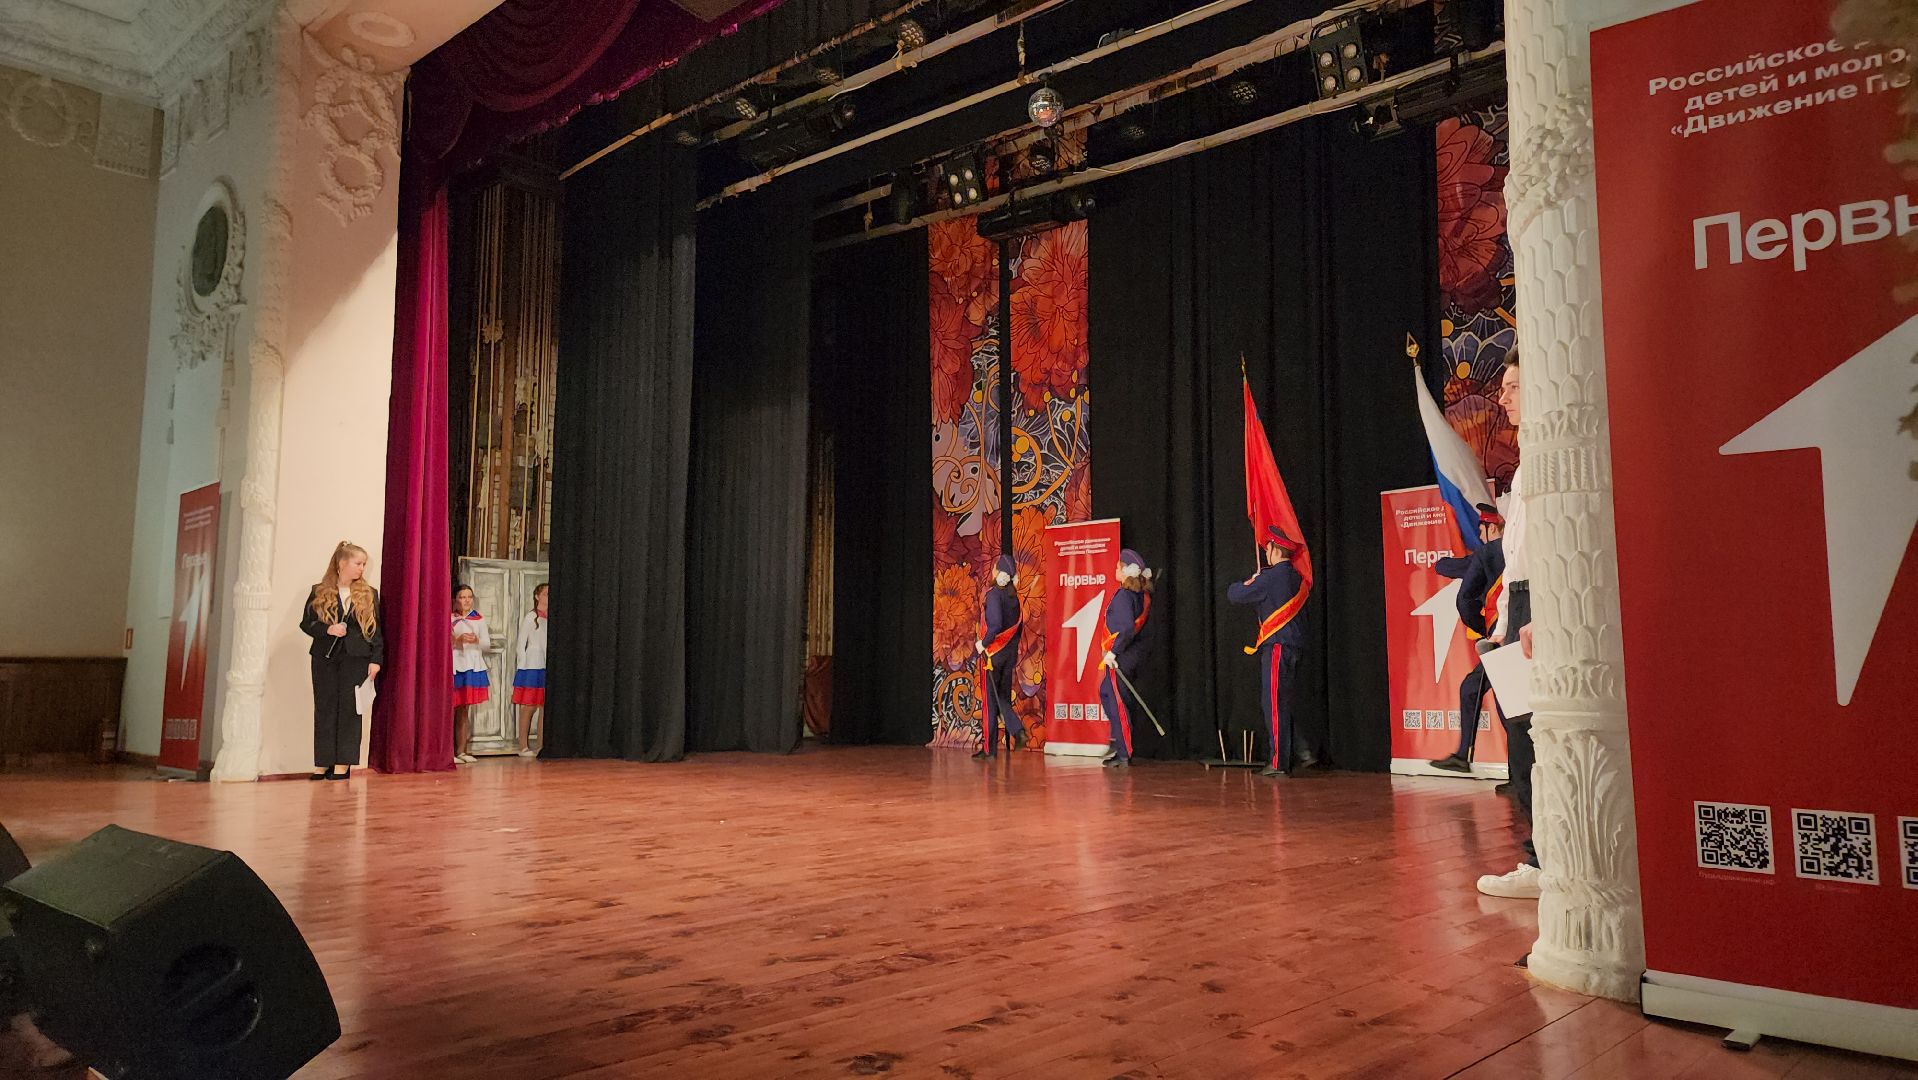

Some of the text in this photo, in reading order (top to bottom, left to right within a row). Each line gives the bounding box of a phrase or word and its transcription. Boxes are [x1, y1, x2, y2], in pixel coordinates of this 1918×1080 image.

[1649, 38, 1844, 96] Российское
[1684, 48, 1911, 114] детей и моло
[1671, 84, 1858, 138] «Движение
[1059, 574, 1106, 589] Первые
